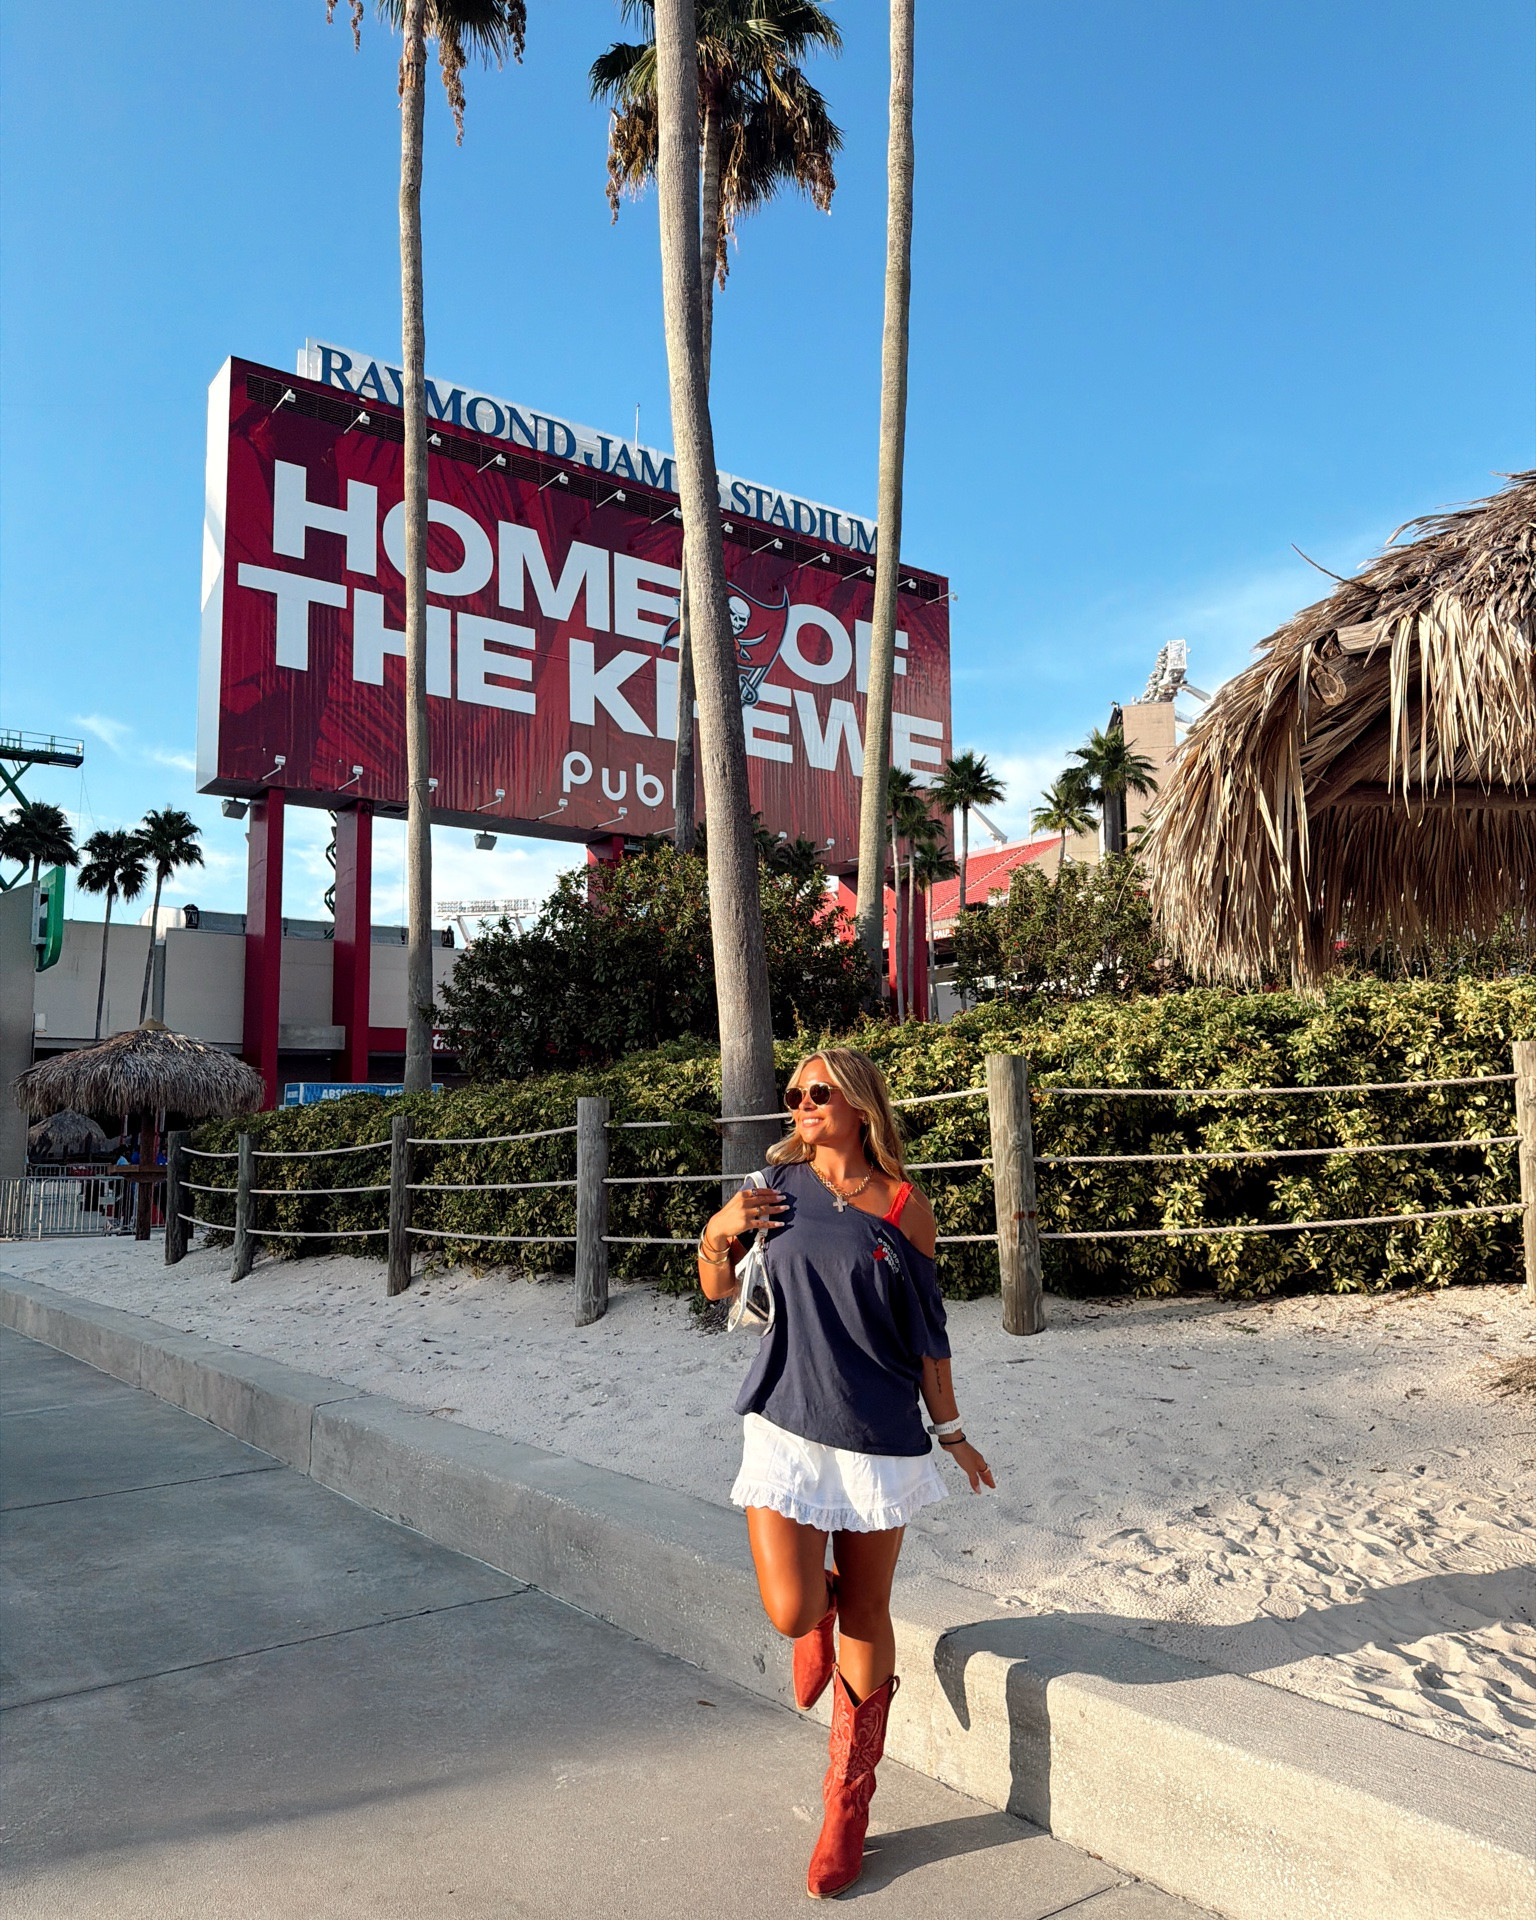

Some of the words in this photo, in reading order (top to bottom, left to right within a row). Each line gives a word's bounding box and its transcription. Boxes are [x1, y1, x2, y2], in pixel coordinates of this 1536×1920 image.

[584, 435, 721, 507] JAM
[731, 481, 877, 557] STADIUM
[237, 562, 536, 716] THE
[272, 459, 682, 650] HOME
[779, 603, 909, 695] OF
